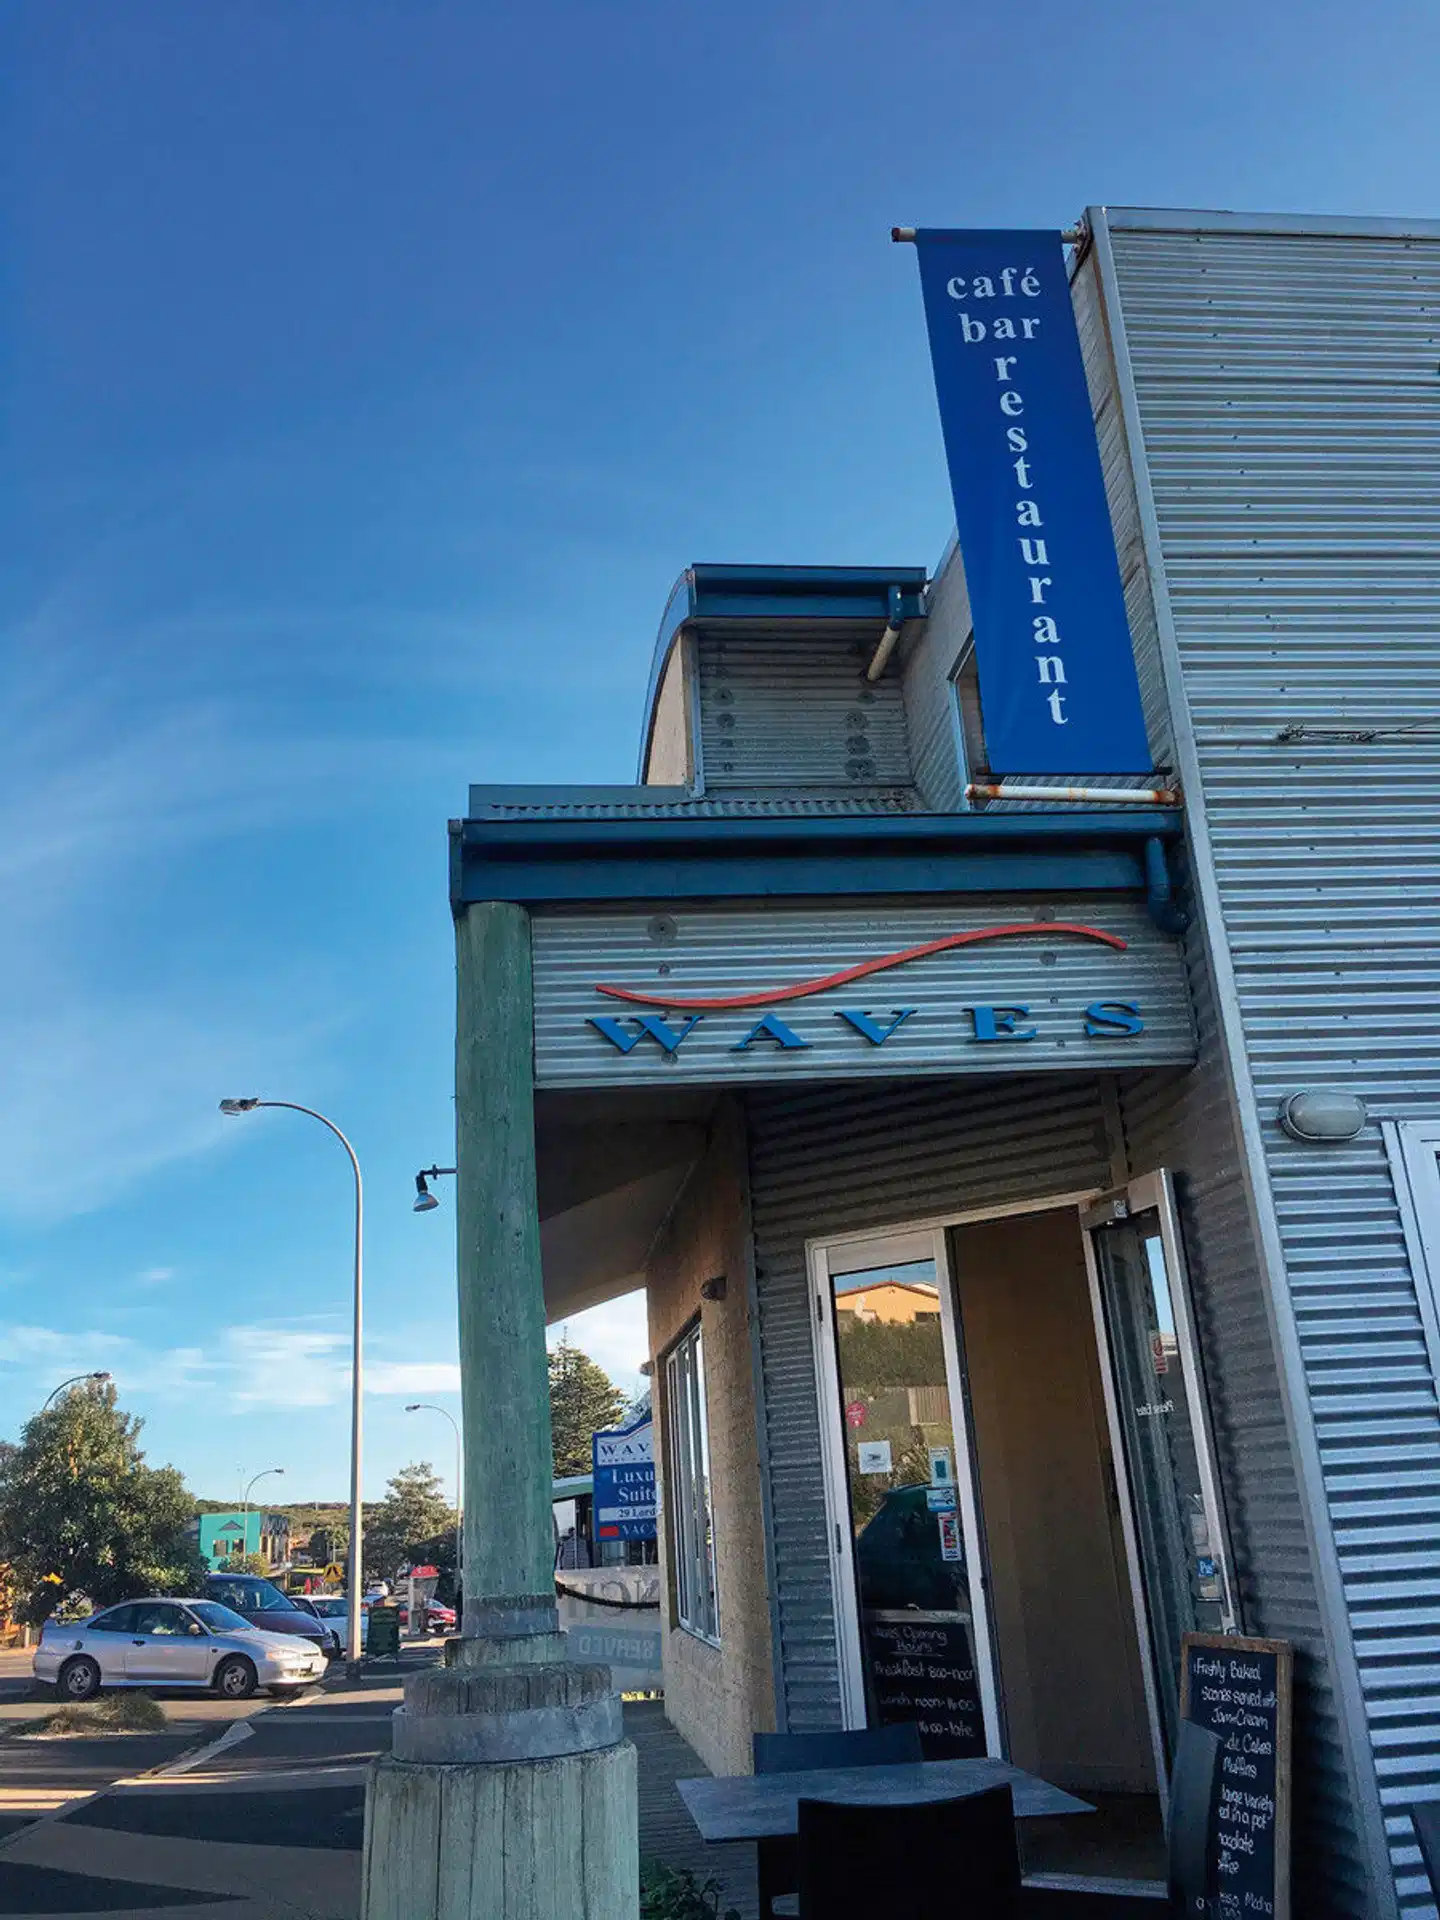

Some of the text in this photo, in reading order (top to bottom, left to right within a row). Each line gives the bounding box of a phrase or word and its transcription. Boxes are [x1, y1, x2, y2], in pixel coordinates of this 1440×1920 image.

[946, 267, 1041, 300] café
[958, 312, 1041, 344] bar
[993, 355, 1069, 725] restaurant
[585, 1001, 1145, 1055] WAVES
[619, 1508, 630, 1518] 29
[1230, 1660, 1262, 1681] Baked
[1251, 1813, 1267, 1832] pot
